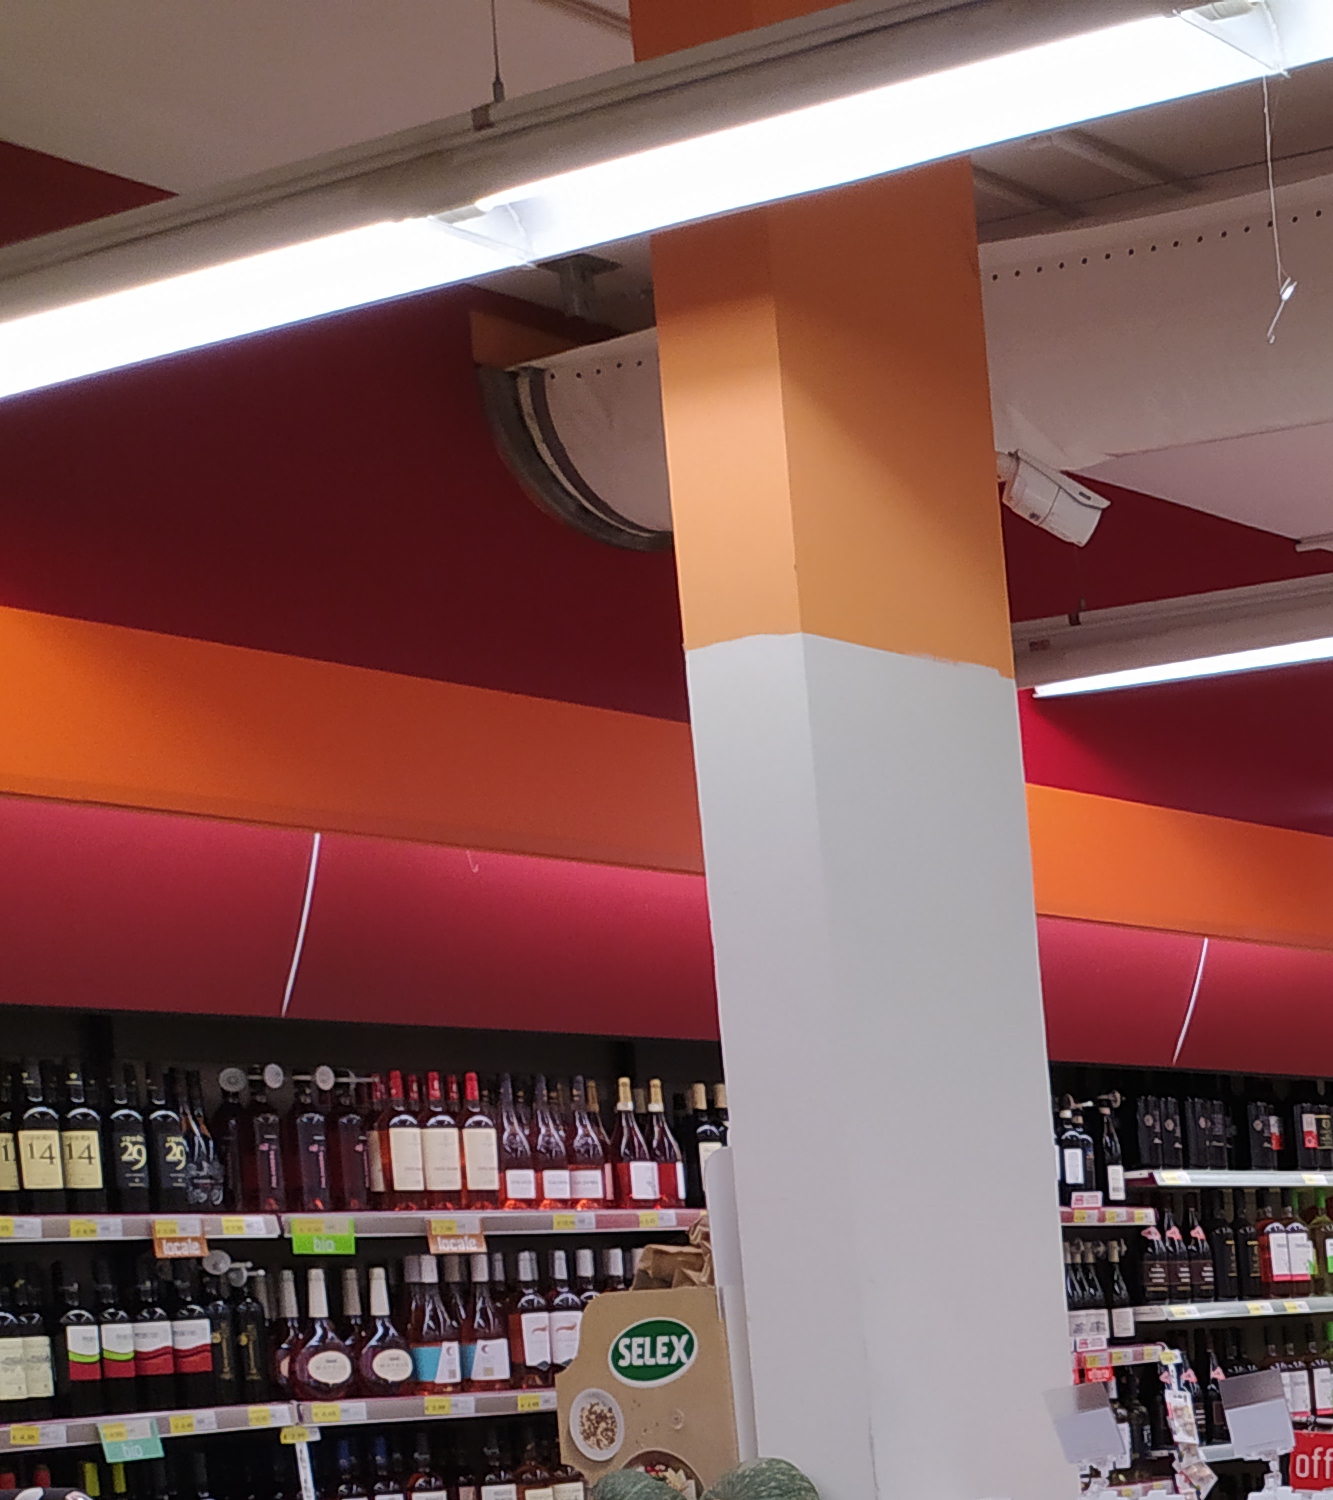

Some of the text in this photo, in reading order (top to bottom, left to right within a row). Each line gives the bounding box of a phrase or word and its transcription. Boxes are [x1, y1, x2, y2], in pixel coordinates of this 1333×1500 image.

[27, 1142, 56, 1166] 14
[64, 1142, 97, 1166] 14
[119, 1141, 148, 1172] 29
[162, 1239, 201, 1255] locale
[436, 1235, 478, 1251] locale
[617, 1333, 690, 1368] SELEX
